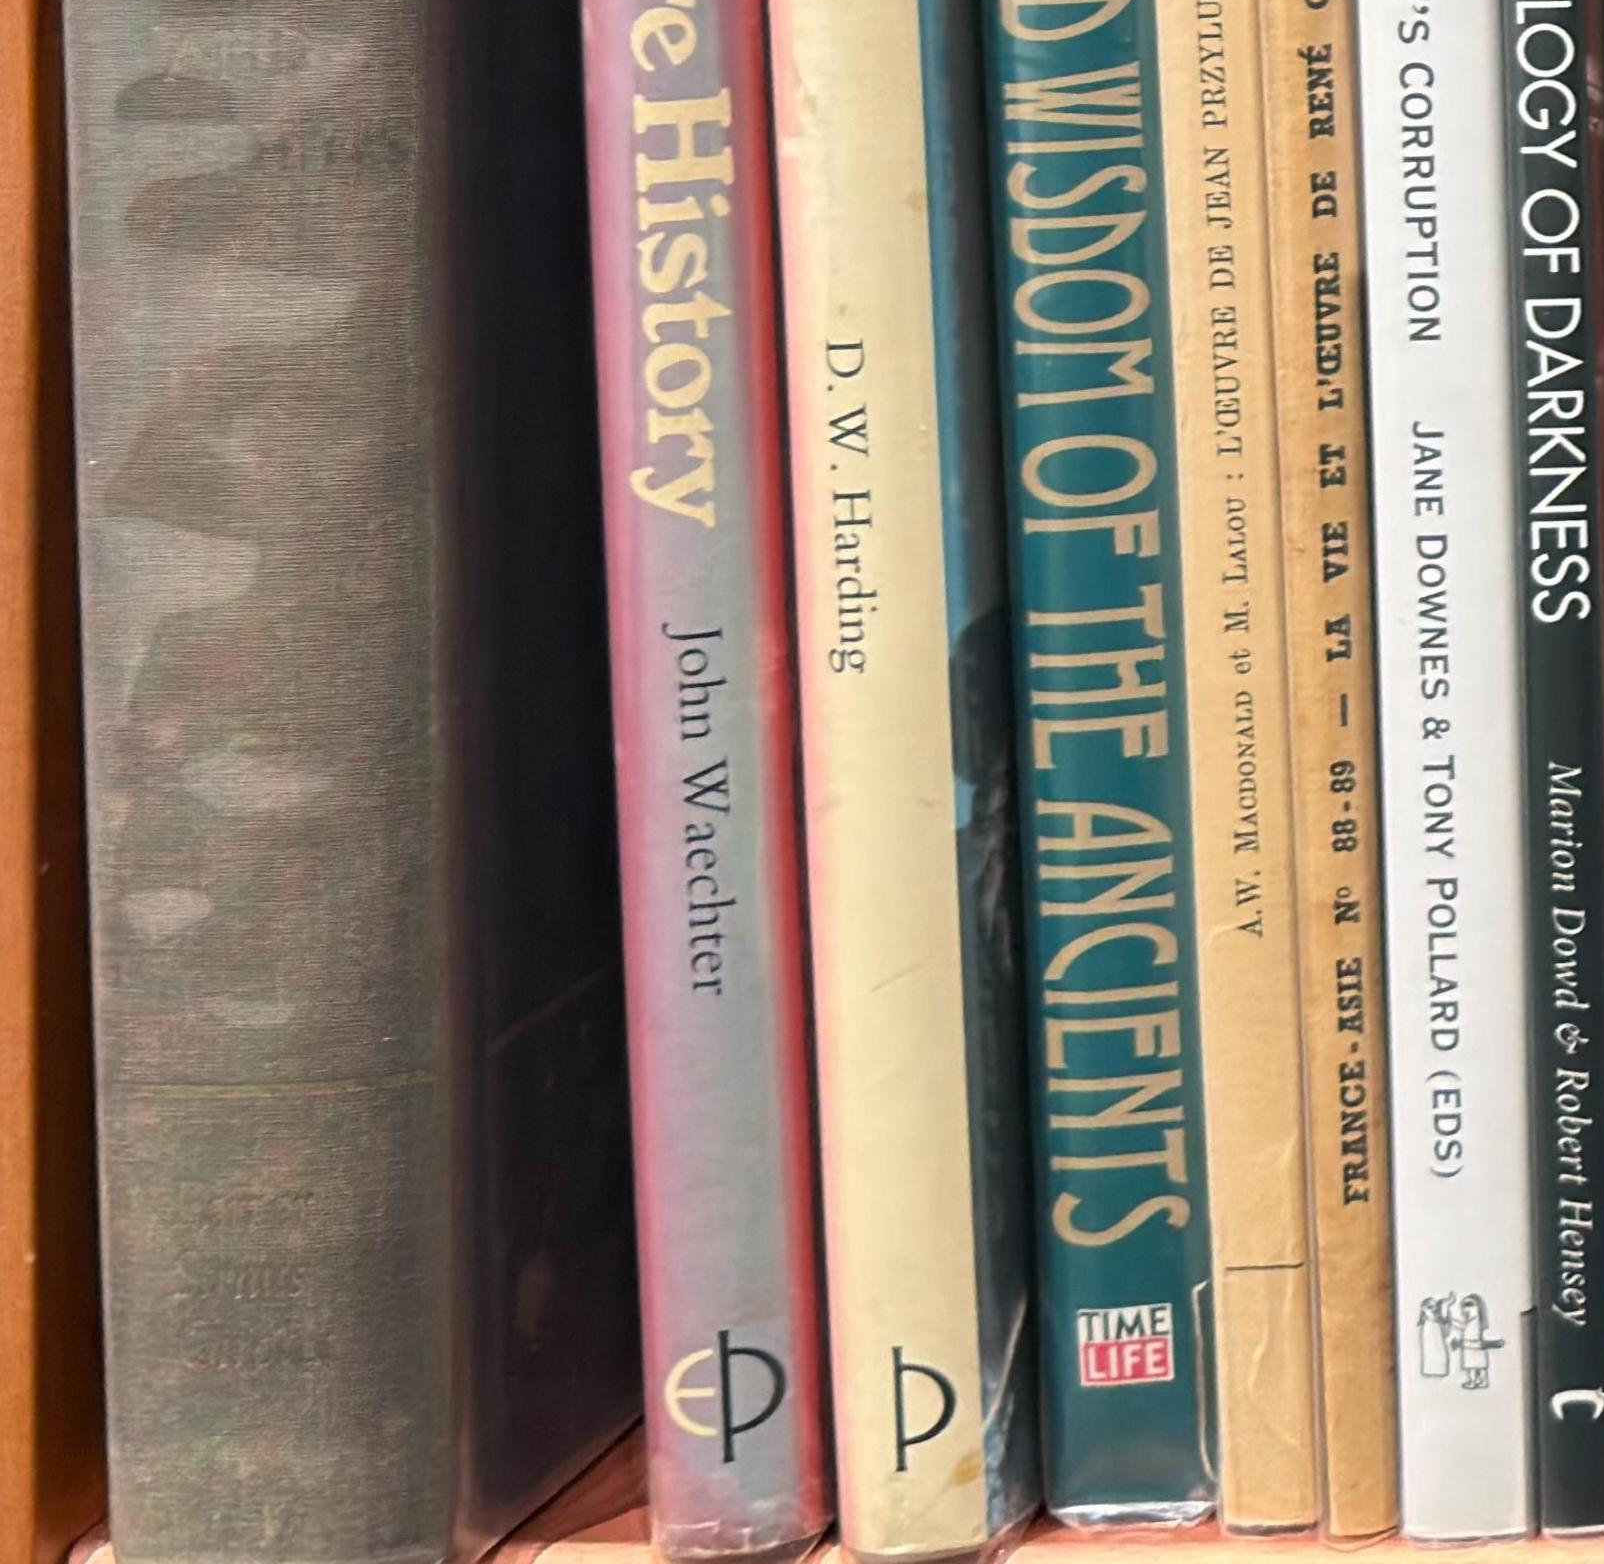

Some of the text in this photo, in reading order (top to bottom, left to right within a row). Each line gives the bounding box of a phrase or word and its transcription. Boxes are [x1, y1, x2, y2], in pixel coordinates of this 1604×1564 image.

[1299, 44, 1334, 139] RENÉ
[1003, 61, 1155, 408] WISDOM
[1206, 147, 1232, 230] JEAN
[1310, 170, 1338, 219] DE
[1398, 64, 1441, 342] CORRUPTION
[1521, 188, 1580, 275] OF
[630, 87, 734, 527] History
[1210, 244, 1234, 291] DE
[824, 340, 877, 674] D. W. Harding
[1021, 434, 1160, 557] OF
[1320, 445, 1346, 488] ET
[1524, 298, 1590, 625] DARKNESS
[1322, 520, 1348, 583] VIE
[1223, 600, 1251, 635] M.
[1236, 648, 1253, 675] et
[1326, 613, 1352, 663] LA
[1027, 585, 1169, 771] THE
[662, 622, 740, 997] John Waechter
[1412, 421, 1464, 1179] JANE DOWNES & TONY POLLARD (EDS)
[1035, 798, 1190, 1248] ANCIENTS
[1547, 761, 1593, 1329] Marion Dowd & Robert Hensey
[1080, 1305, 1170, 1340] TIME
[1087, 1341, 1168, 1382] LIFE
